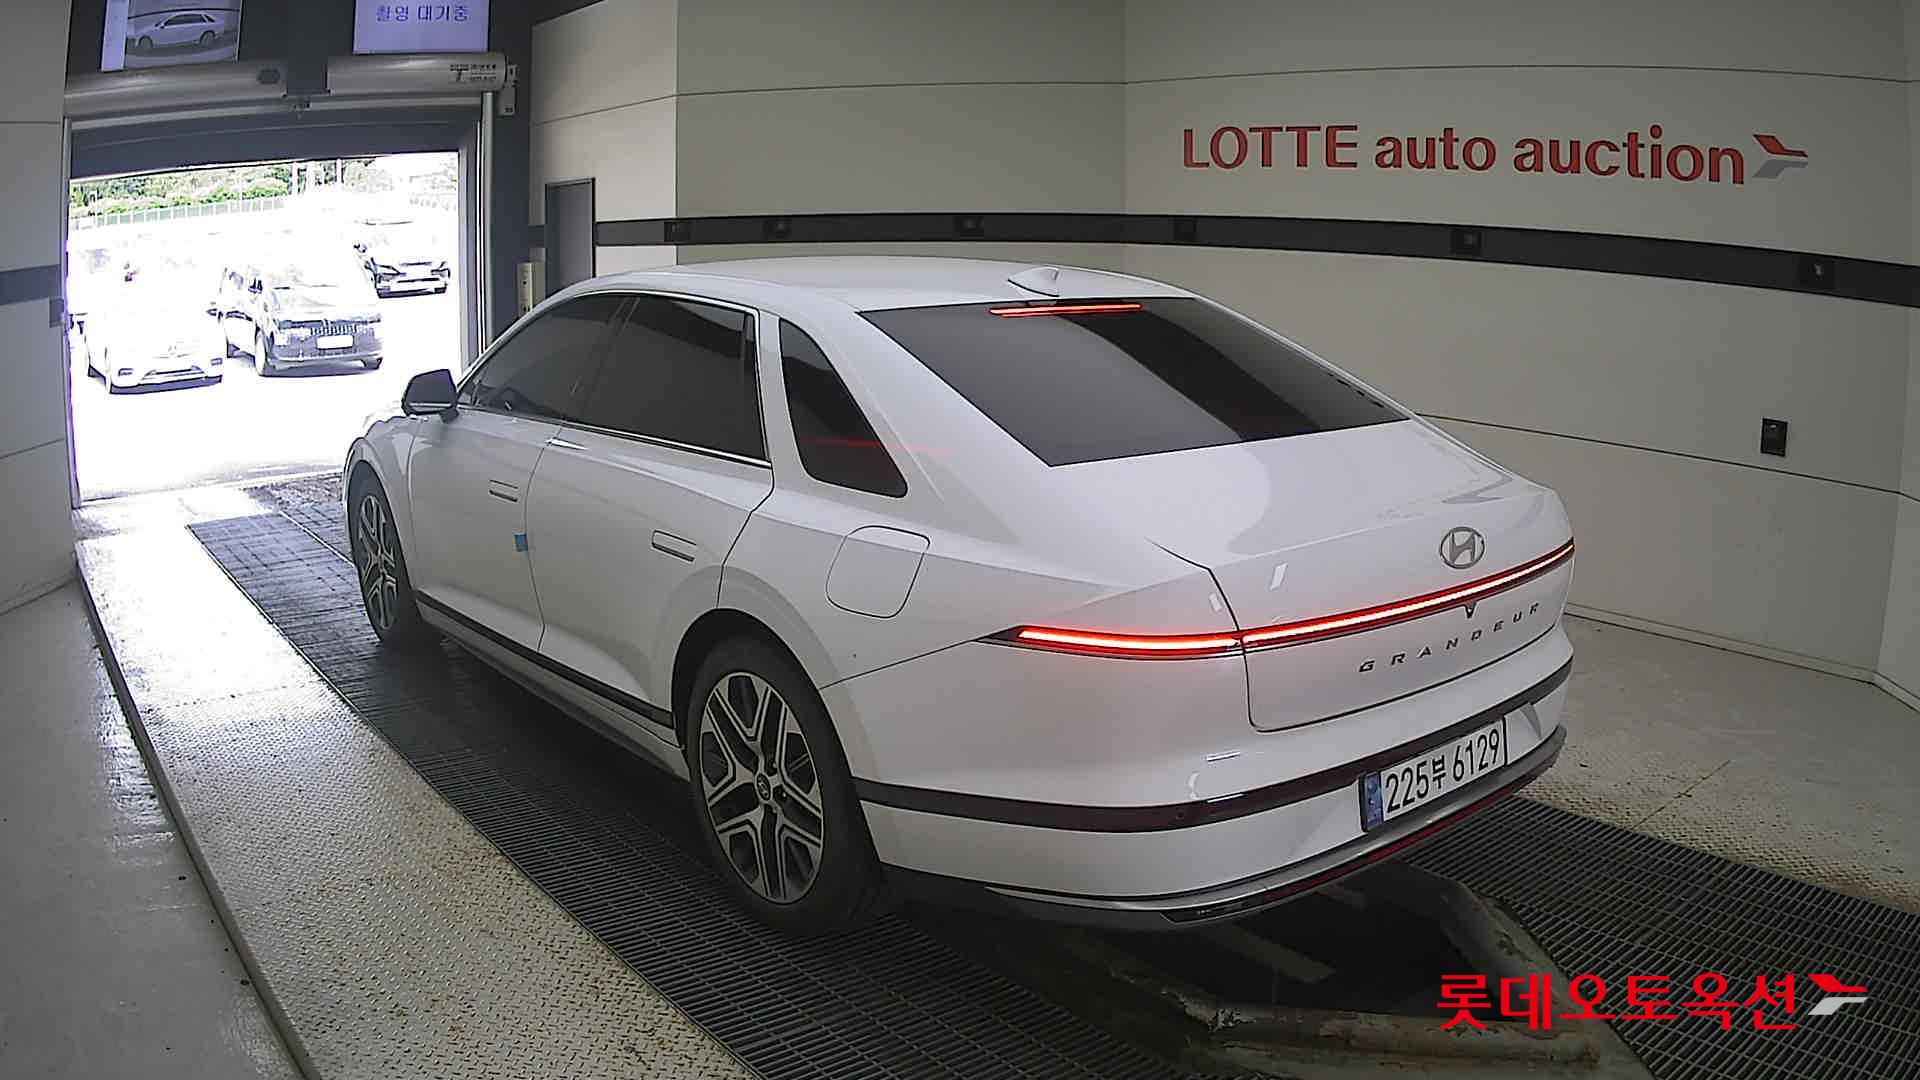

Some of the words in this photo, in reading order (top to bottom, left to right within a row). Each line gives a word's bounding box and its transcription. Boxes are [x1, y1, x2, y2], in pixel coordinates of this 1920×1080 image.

[417, 5, 468, 22] 대기중
[1183, 125, 1358, 169] LOTTE
[1375, 127, 1496, 171] auto
[1513, 125, 1744, 185] auction
[1359, 603, 1539, 673] GRANDEUR
[1385, 755, 1447, 813] 225부
[1453, 728, 1500, 783] 6129
